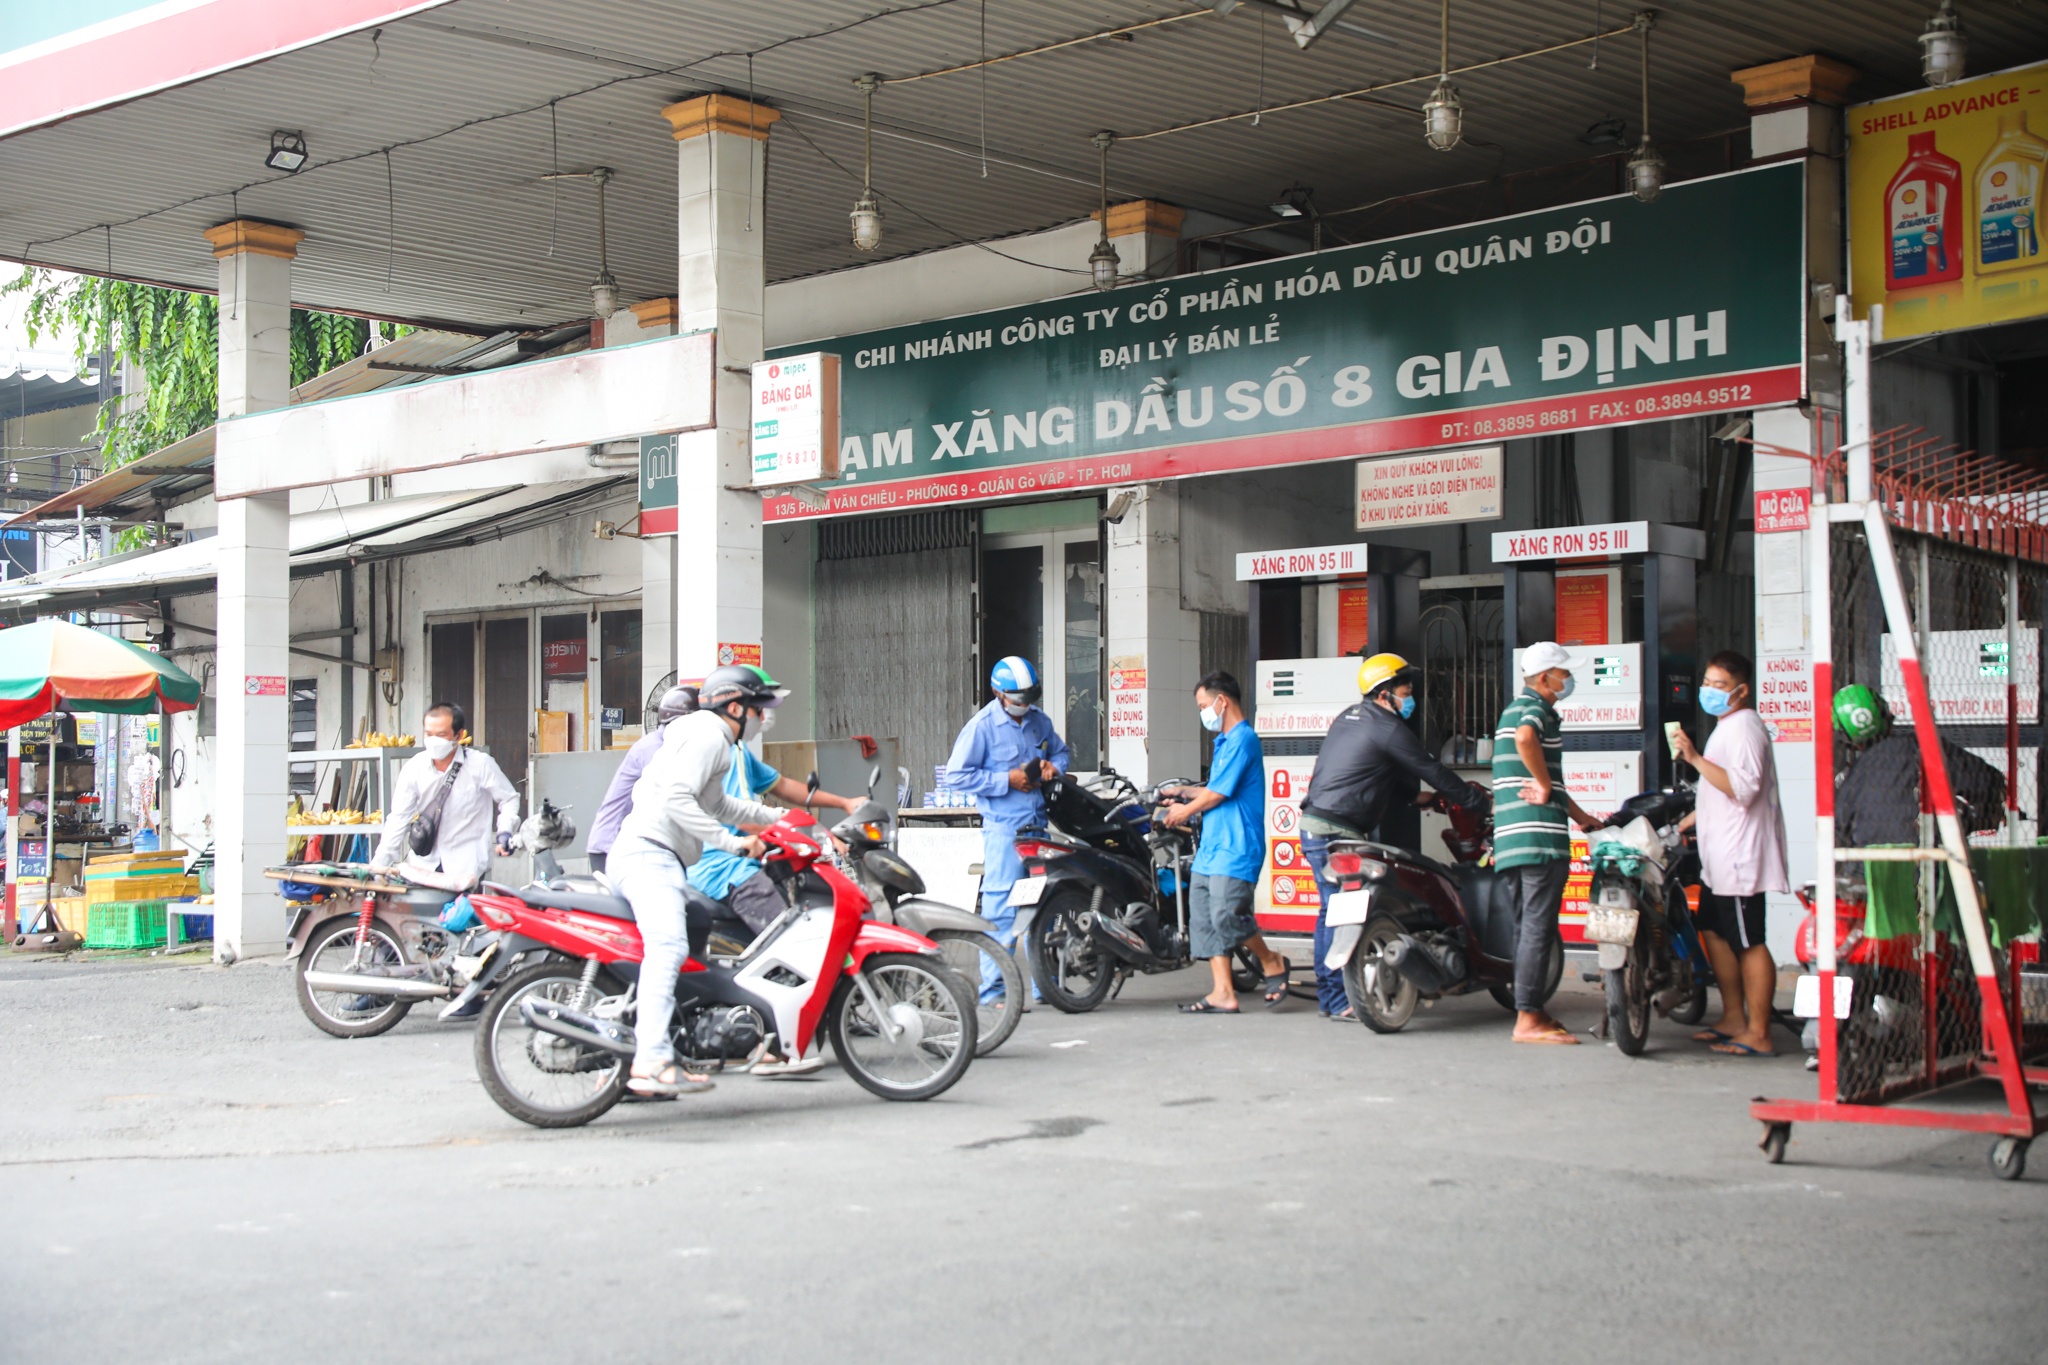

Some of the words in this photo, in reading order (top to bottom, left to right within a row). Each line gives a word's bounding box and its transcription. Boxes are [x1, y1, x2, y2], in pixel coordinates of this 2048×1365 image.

[1862, 111, 1918, 135] SHELL
[1924, 87, 2019, 122] ADVANCE
[1983, 196, 2032, 214] ADVANCE
[1895, 214, 1940, 230] ADVANCE
[854, 346, 896, 370] CHI
[904, 326, 992, 361] NHÁNH
[1000, 316, 1075, 346] CÔNG
[1083, 308, 1120, 332] TY
[1128, 287, 1169, 322] CỔ
[1180, 278, 1263, 317] PHẦN
[1274, 267, 1340, 301] HÓA
[1353, 250, 1422, 287] DẦU
[1435, 234, 1532, 275] QUÂN
[1545, 217, 1612, 256] ĐỘI
[1099, 345, 1142, 370] ĐẠI
[1148, 332, 1178, 360] LÝ
[1188, 325, 1240, 356] BÁN
[1248, 313, 1280, 344] LẺ
[762, 384, 791, 405] BẢNG
[795, 380, 812, 400] GIÁ
[841, 427, 914, 480] ẠM
[930, 409, 1075, 462] XĂNG
[1095, 377, 1215, 440] DẦU
[1224, 355, 1312, 420] SỐ
[1332, 365, 1373, 408] 8
[1396, 346, 1511, 400] GIA
[1538, 310, 1728, 384] ĐỊNH
[1442, 422, 1468, 438] ĐT:
[1474, 414, 1534, 435] 08.3895
[1540, 408, 1576, 426] 8681
[1589, 401, 1630, 420] FAX:
[1636, 385, 1751, 414] 08.3894.9512
[1374, 466, 1388, 480] XIN
[1390, 461, 1406, 478] QUÝ
[1409, 459, 1437, 476] KHÁCH
[1440, 459, 1454, 472] VUI
[775, 503, 795, 516] 13/5
[834, 494, 857, 509] VĂN
[860, 490, 896, 506] CHIÊU
[907, 483, 957, 501] PHƯỜNG
[961, 483, 968, 496] 9
[978, 476, 1014, 494] QUẬN
[1039, 467, 1065, 486] VẤP
[1077, 468, 1097, 482] TP.
[1102, 464, 1131, 479] HCM
[1361, 485, 1389, 502] KHÔNG
[1392, 484, 1414, 498] NGHE
[1417, 480, 1428, 496] VÀ
[1430, 482, 1444, 498] GỌI
[1447, 476, 1467, 496] ĐIỆN
[1470, 476, 1495, 492] THOẠI
[1369, 508, 1385, 521] KHU
[1388, 504, 1404, 523] VỰC
[1406, 501, 1423, 518] CÂY
[1761, 492, 1778, 515] MỞ
[1780, 490, 1804, 513] CỬA
[1509, 534, 1548, 557] XĂNG
[1554, 534, 1583, 554] RON
[1589, 531, 1608, 551] 95
[1614, 530, 1628, 549] III
[1252, 555, 1285, 575] XĂNG
[1290, 554, 1314, 573] RON
[1320, 552, 1335, 570] 95
[1341, 551, 1352, 569] III
[1623, 665, 1629, 676] 2
[1266, 680, 1271, 690] 4
[1763, 677, 1776, 694] SỬ
[1779, 680, 1807, 697] DỤNG
[606, 709, 618, 718] 458
[1562, 706, 1593, 722] TRƯỚC
[1596, 708, 1612, 721] KHI
[1759, 698, 1780, 717] ĐIỆN
[1784, 701, 1811, 716] THOẠI
[1940, 696, 1979, 715] TRƯỚC
[1983, 700, 2003, 714] KHI
[1113, 708, 1122, 721] SỬ
[1124, 711, 1143, 724] DỤNG
[1258, 712, 1273, 729] TRẢ
[1297, 713, 1323, 729] TRƯỚC
[1110, 724, 1125, 739] ĐIỆN
[1127, 726, 1145, 739] THOẠI
[1566, 902, 1576, 911] NO
